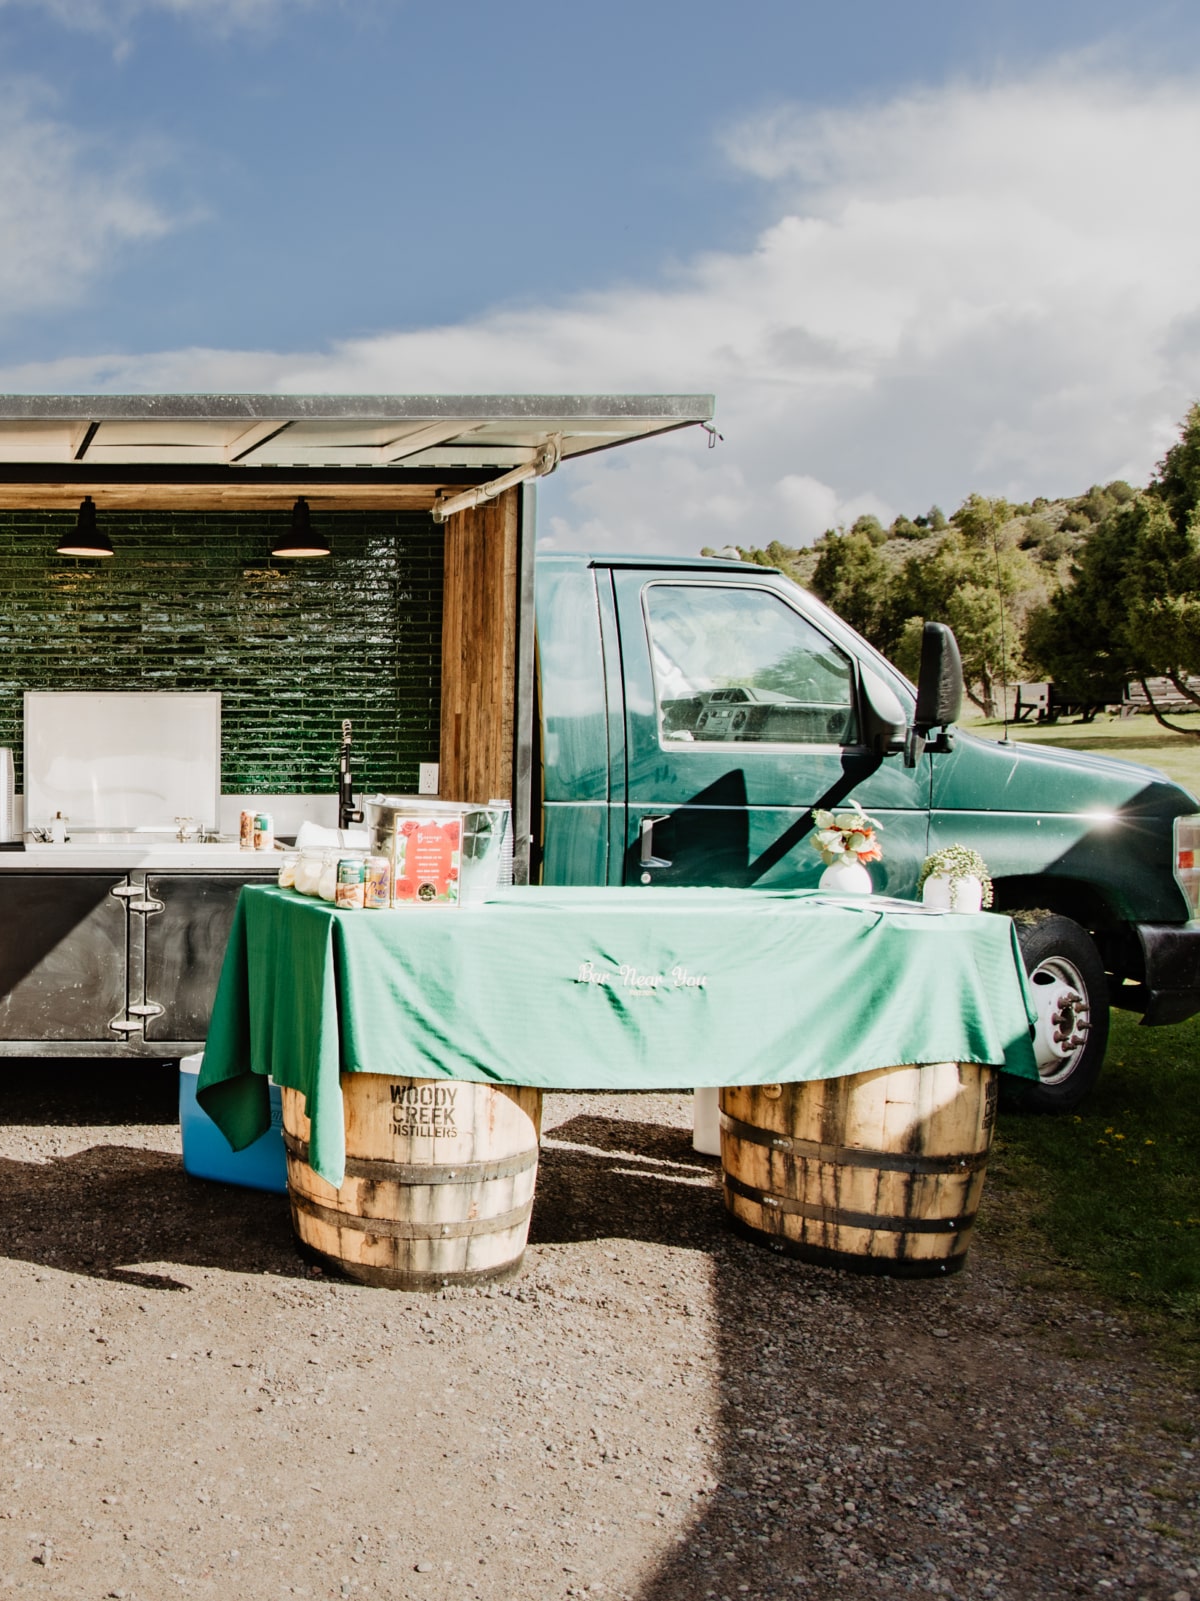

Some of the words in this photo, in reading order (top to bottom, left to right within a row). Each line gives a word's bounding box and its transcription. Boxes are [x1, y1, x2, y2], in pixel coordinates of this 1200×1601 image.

[578, 962, 610, 984] Bar
[620, 965, 663, 987] Near
[672, 967, 708, 987] You
[390, 1085, 458, 1106] WOODY
[392, 1105, 456, 1125] CREEK
[388, 1123, 458, 1138] DISTILLERS
